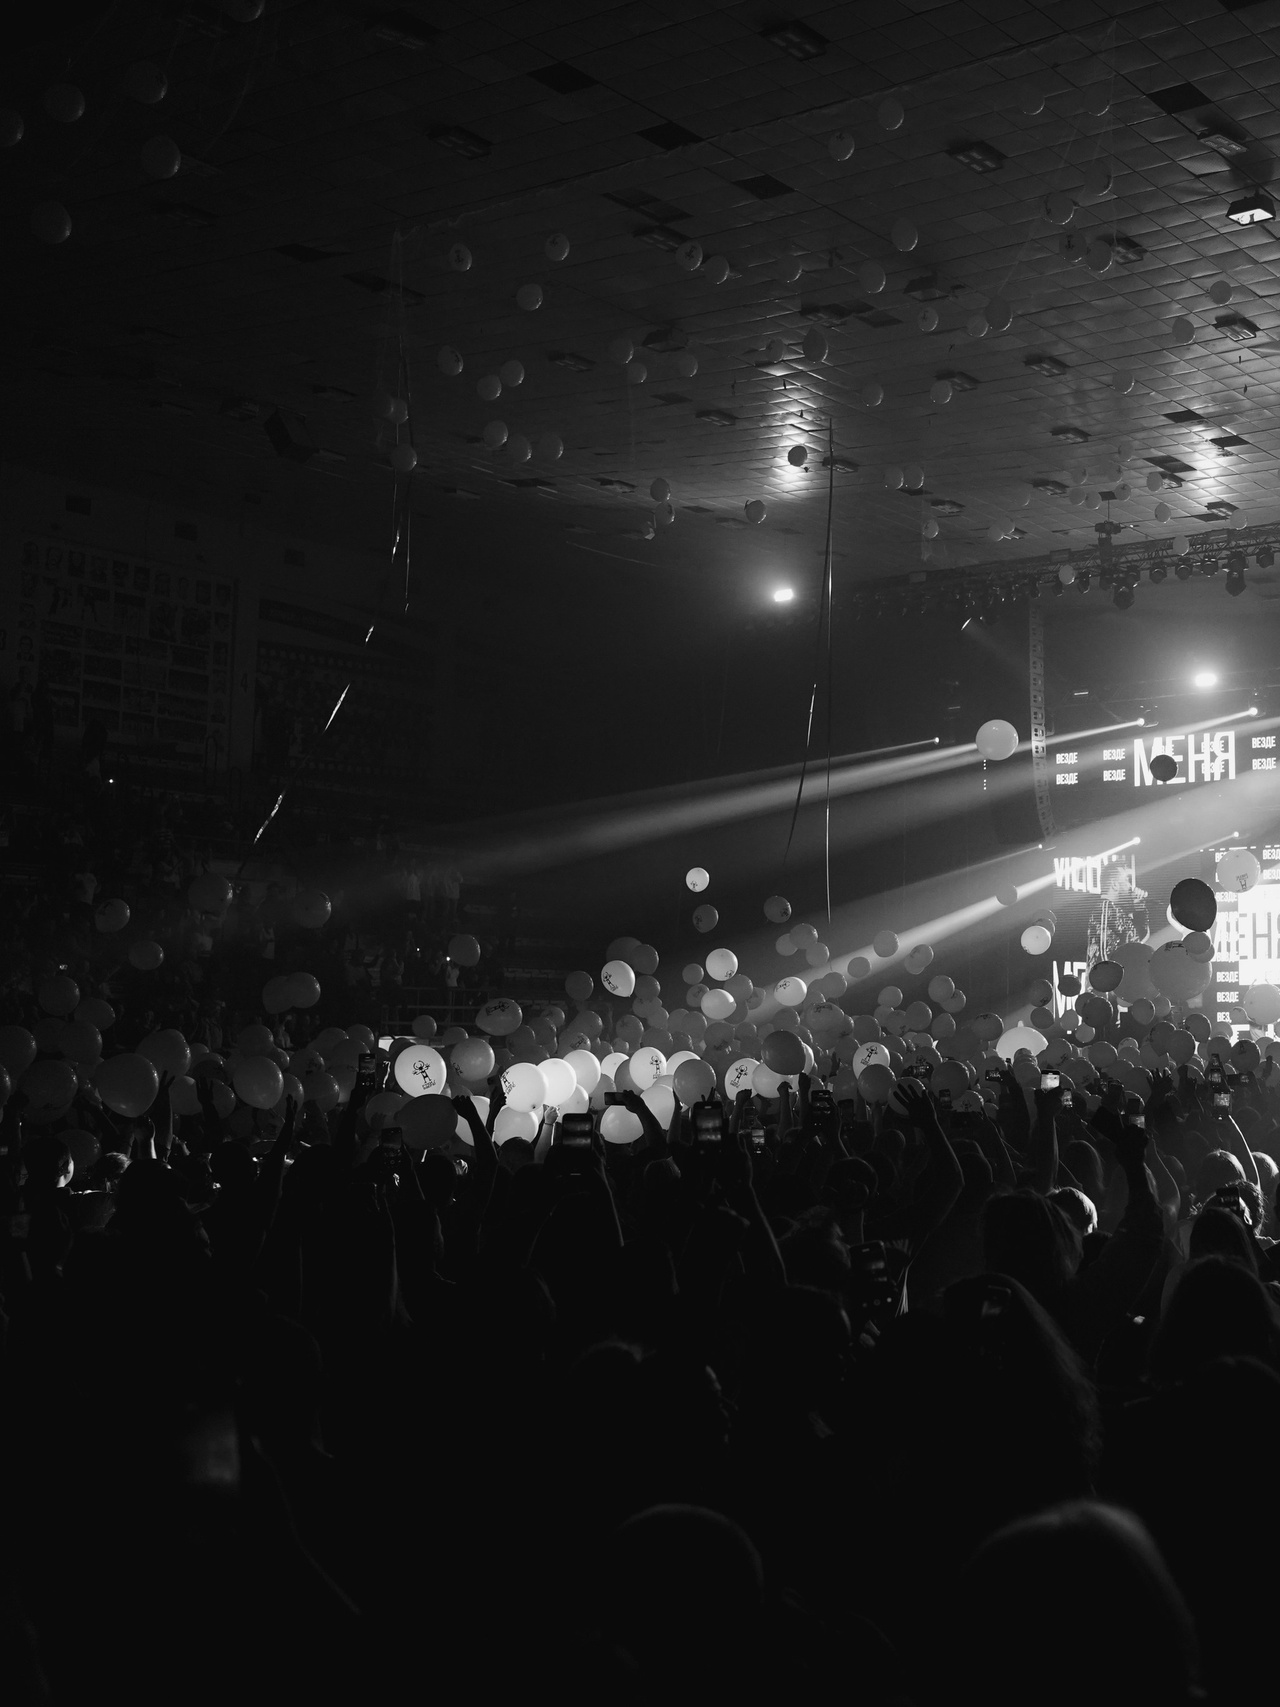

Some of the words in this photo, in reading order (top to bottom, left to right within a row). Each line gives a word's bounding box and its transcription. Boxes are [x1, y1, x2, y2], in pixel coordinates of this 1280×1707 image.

[1252, 736, 1276, 749] ВЕЗДЕ
[1056, 752, 1078, 764] ВЕЗДЕ
[1103, 749, 1126, 761] ВЕЗДЕ
[1134, 731, 1236, 786] МЕНЯ
[1252, 757, 1277, 770] ВЕЗДЕ
[1056, 773, 1078, 785] ВЕЗДЕ
[1103, 769, 1126, 781] ВЕЗДЕ
[1216, 892, 1238, 902] ВЕЗДЕ
[1217, 971, 1239, 982] ВЕЗДЕ
[1217, 991, 1239, 1002] ВЕЗДЕ
